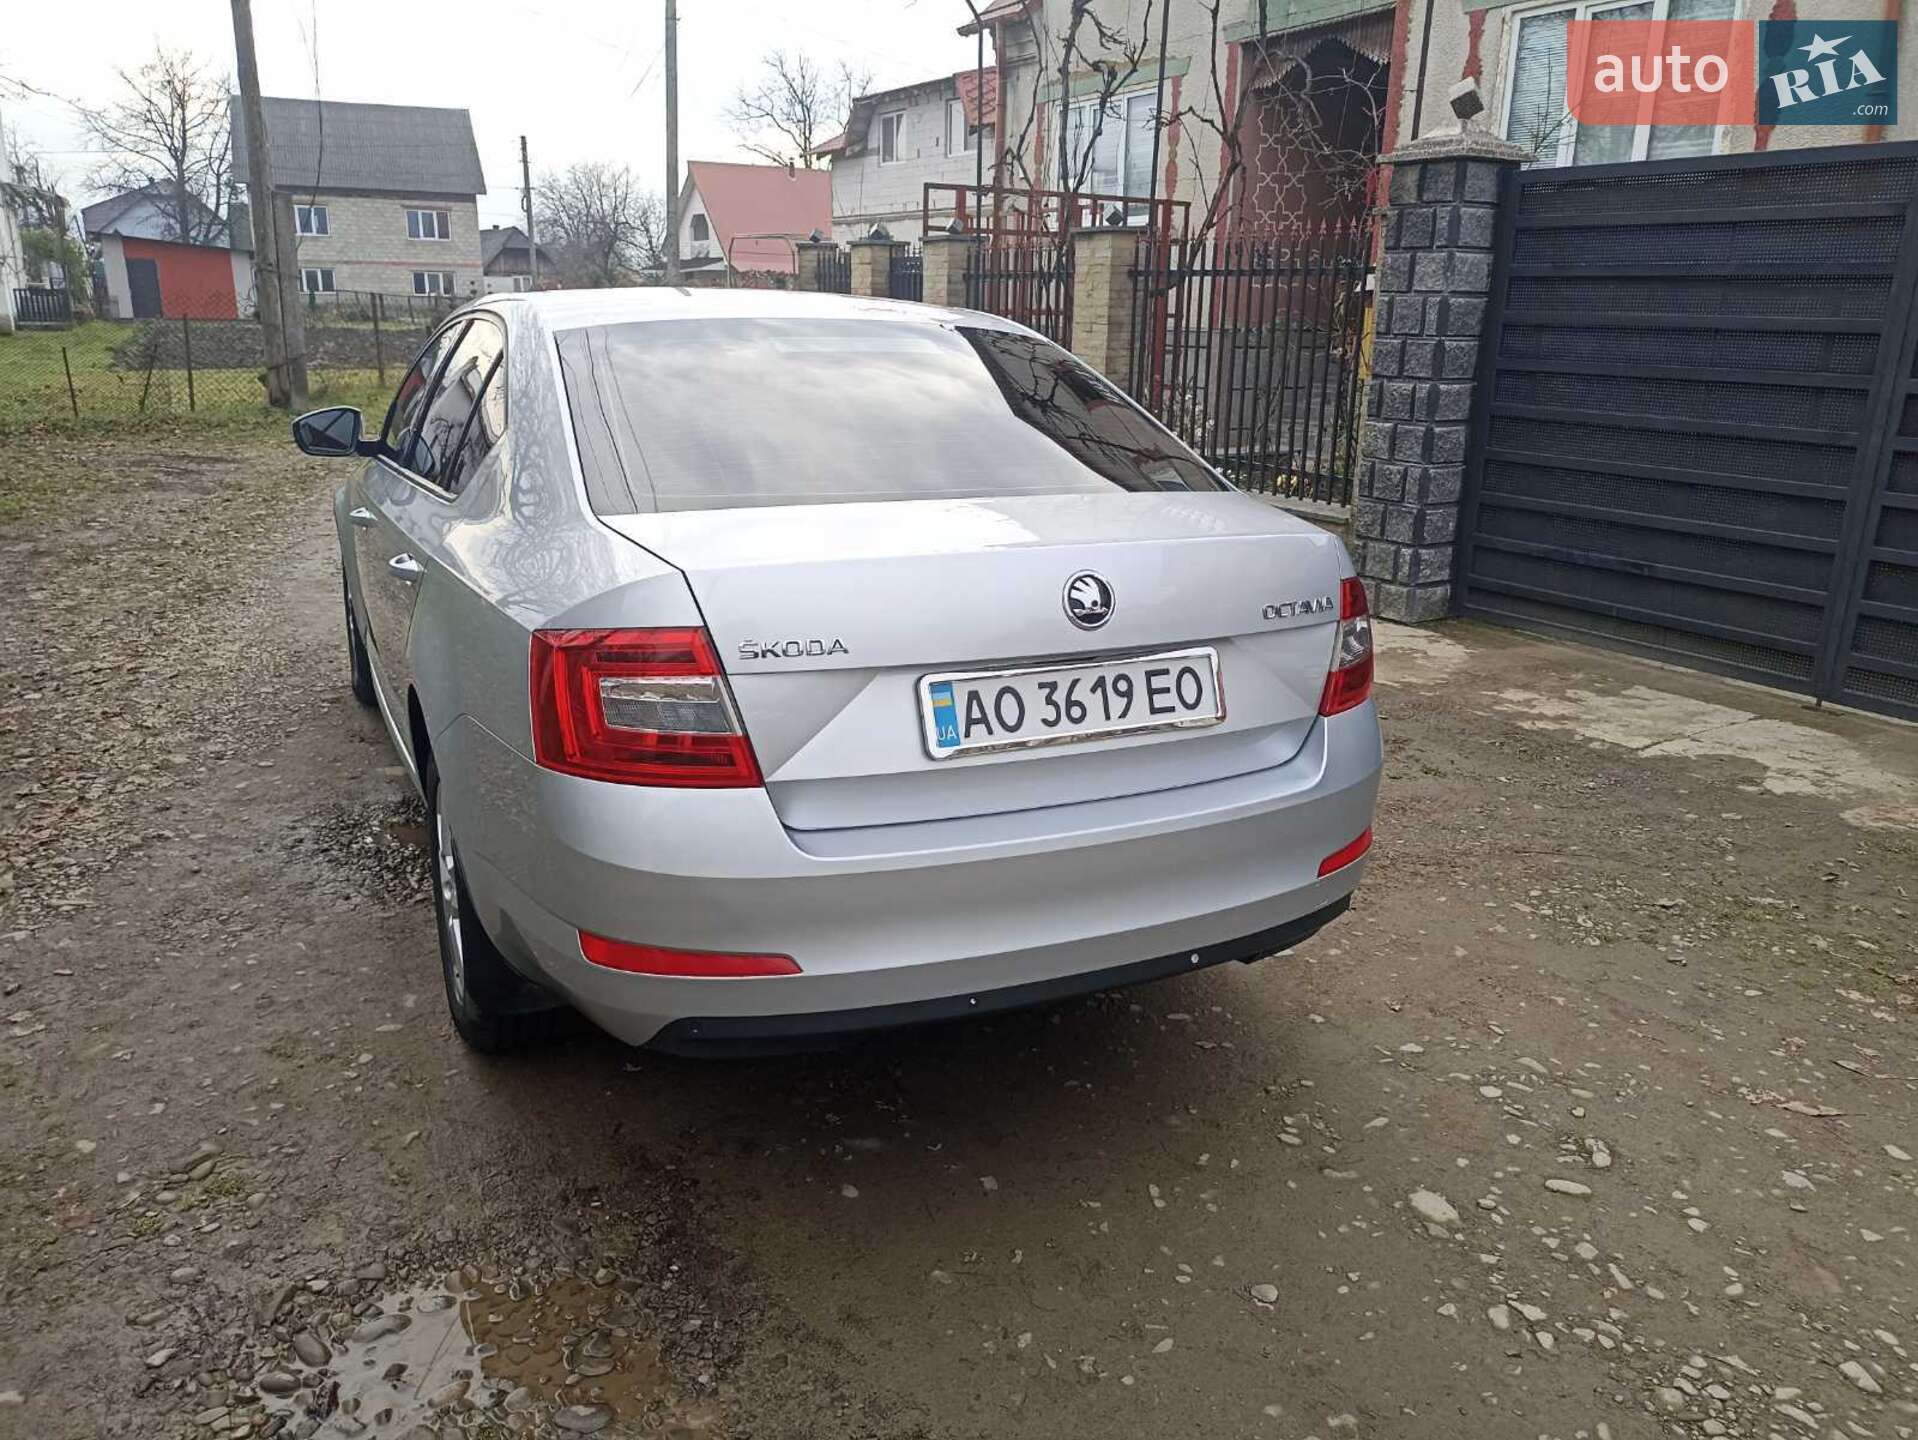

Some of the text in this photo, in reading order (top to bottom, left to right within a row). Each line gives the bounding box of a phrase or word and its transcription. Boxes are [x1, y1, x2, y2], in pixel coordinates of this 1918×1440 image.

[1261, 596, 1334, 620] OCTAVIA
[738, 637, 849, 660] ŠKODA
[964, 666, 1203, 738] AO 3619 EO
